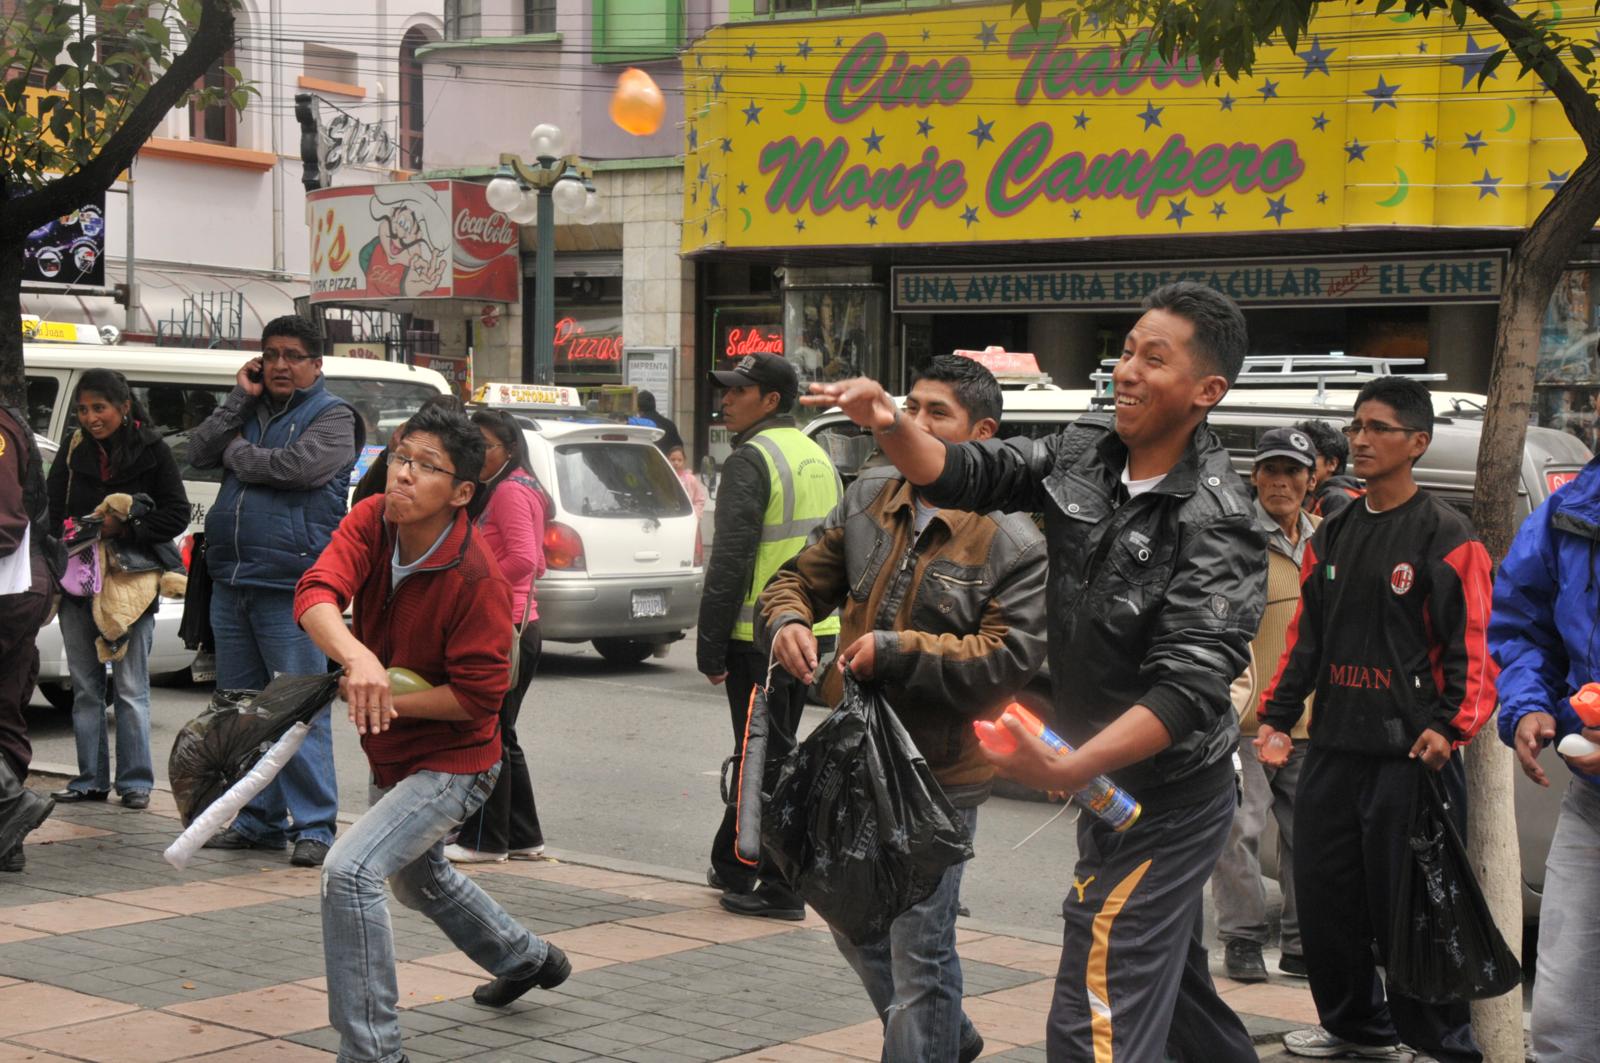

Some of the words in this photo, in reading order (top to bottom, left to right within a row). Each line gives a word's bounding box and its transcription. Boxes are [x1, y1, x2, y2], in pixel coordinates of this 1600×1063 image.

[824, 31, 973, 124] Cine
[759, 135, 967, 230] Monje
[985, 121, 1306, 219] Campero
[329, 276, 358, 292] PIZZA
[903, 275, 958, 303] UNA
[965, 271, 1106, 302] AVENTURA
[1379, 264, 1410, 295] EL
[1419, 260, 1493, 294] CINE
[554, 317, 624, 360] Pizzas
[630, 361, 668, 371] IMPRENTA
[1329, 663, 1393, 689] MILAN
